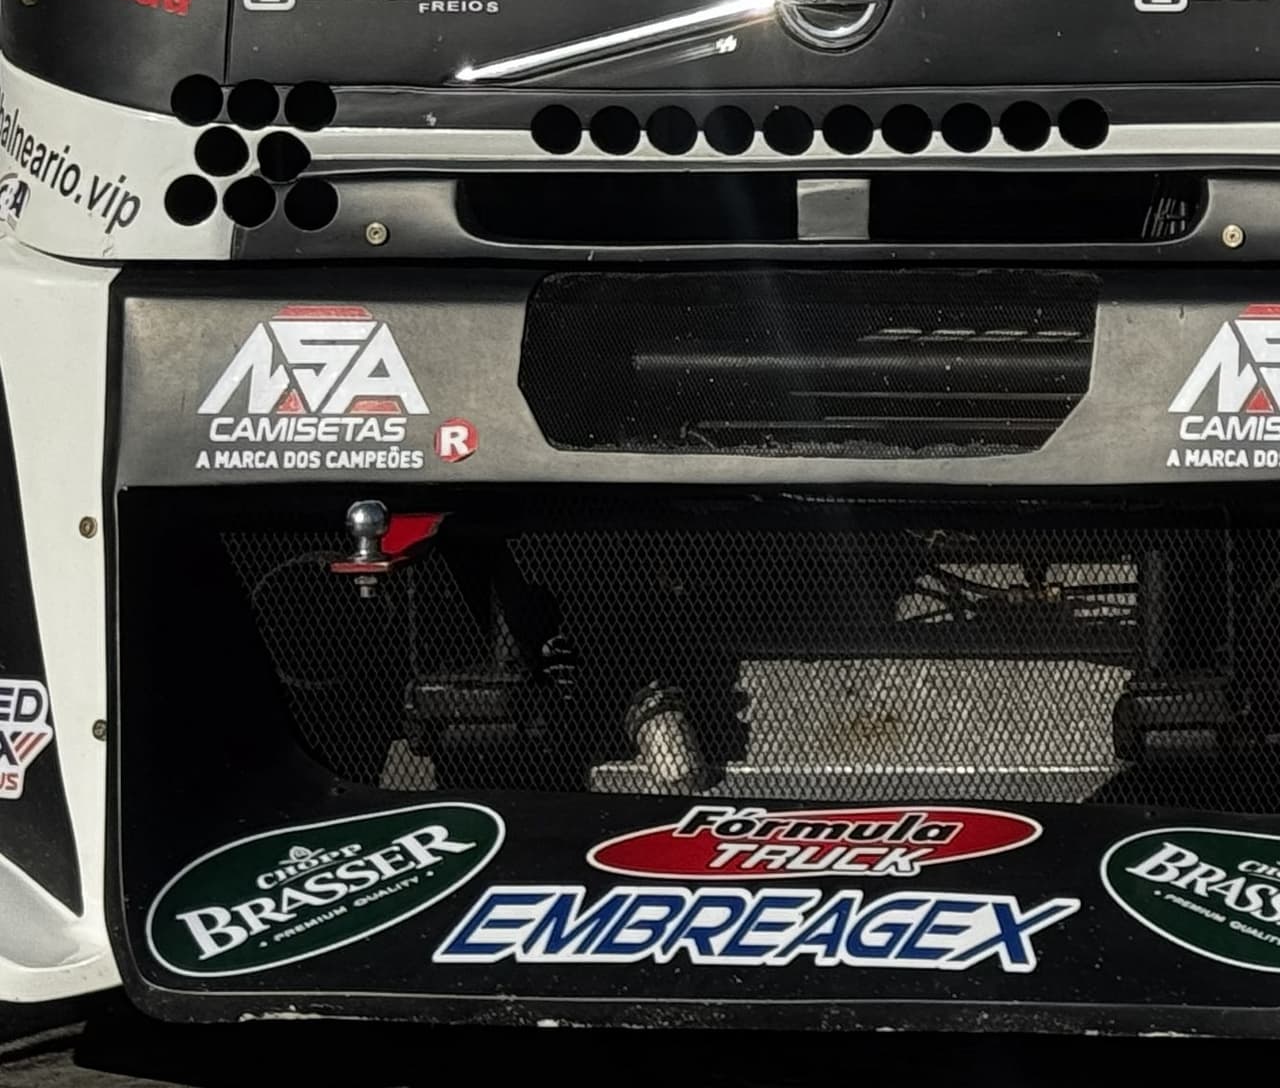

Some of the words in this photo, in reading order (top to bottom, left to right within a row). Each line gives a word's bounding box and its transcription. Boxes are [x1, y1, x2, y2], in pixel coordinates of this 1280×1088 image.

[418, 1, 500, 14] FREIOS
[208, 416, 408, 442] CAMISETAS
[439, 427, 470, 458] R
[195, 450, 211, 469] A
[213, 450, 279, 470] MARCA
[282, 450, 322, 469] DOS
[325, 445, 425, 470] CAMPEÕES
[1165, 449, 1181, 468] A
[1184, 450, 1249, 469] MARCA
[672, 804, 962, 848] Fórmula
[256, 842, 363, 891] CHOPP
[708, 842, 937, 876] TRUCK
[175, 825, 478, 961] BRASSER
[273, 906, 348, 944] PREMIUM
[353, 875, 421, 908] QUALITY
[1164, 893, 1227, 925] PREMIUM
[432, 885, 1081, 973] EMBREAGEX
